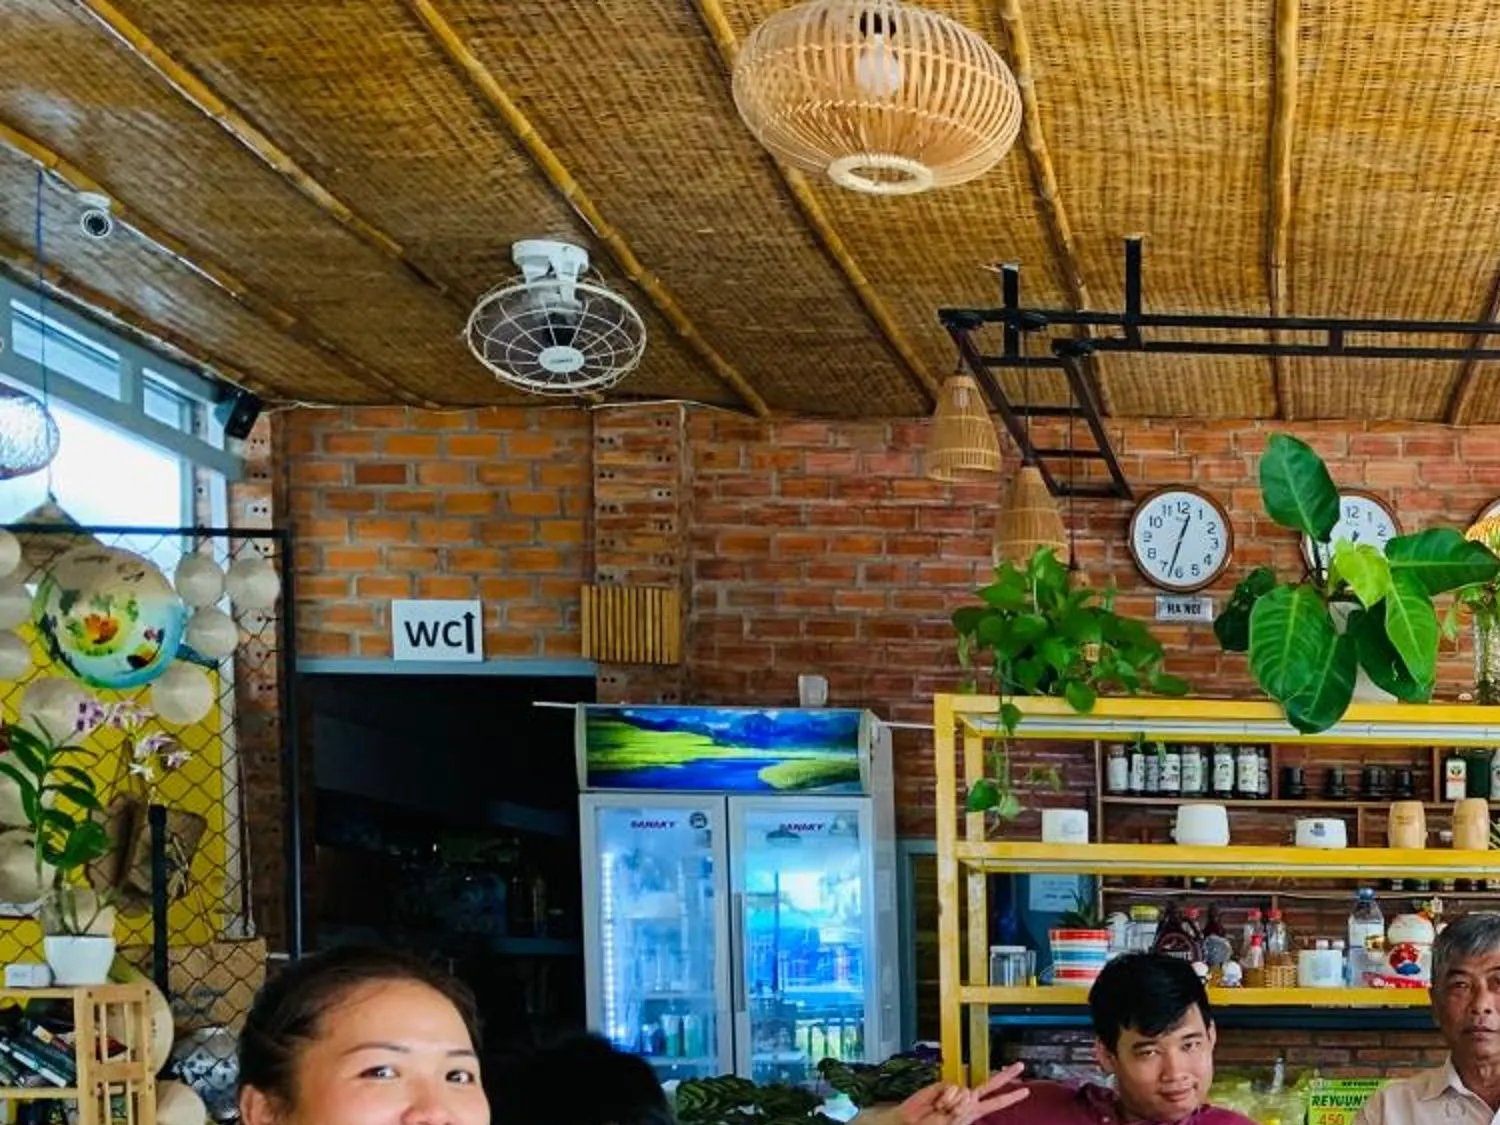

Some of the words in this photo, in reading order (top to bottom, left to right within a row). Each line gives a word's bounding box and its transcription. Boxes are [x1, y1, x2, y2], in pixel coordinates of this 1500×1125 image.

[1162, 504, 1173, 516] 11
[1176, 501, 1191, 514] 12
[1344, 505, 1360, 519] 12
[1149, 515, 1163, 529] 10
[1207, 521, 1217, 534] 2
[1147, 547, 1157, 560] 8
[1203, 553, 1212, 566] 4
[1160, 559, 1169, 572] 7
[1191, 563, 1201, 576] 5
[1174, 566, 1184, 579] 6
[404, 621, 463, 648] WC
